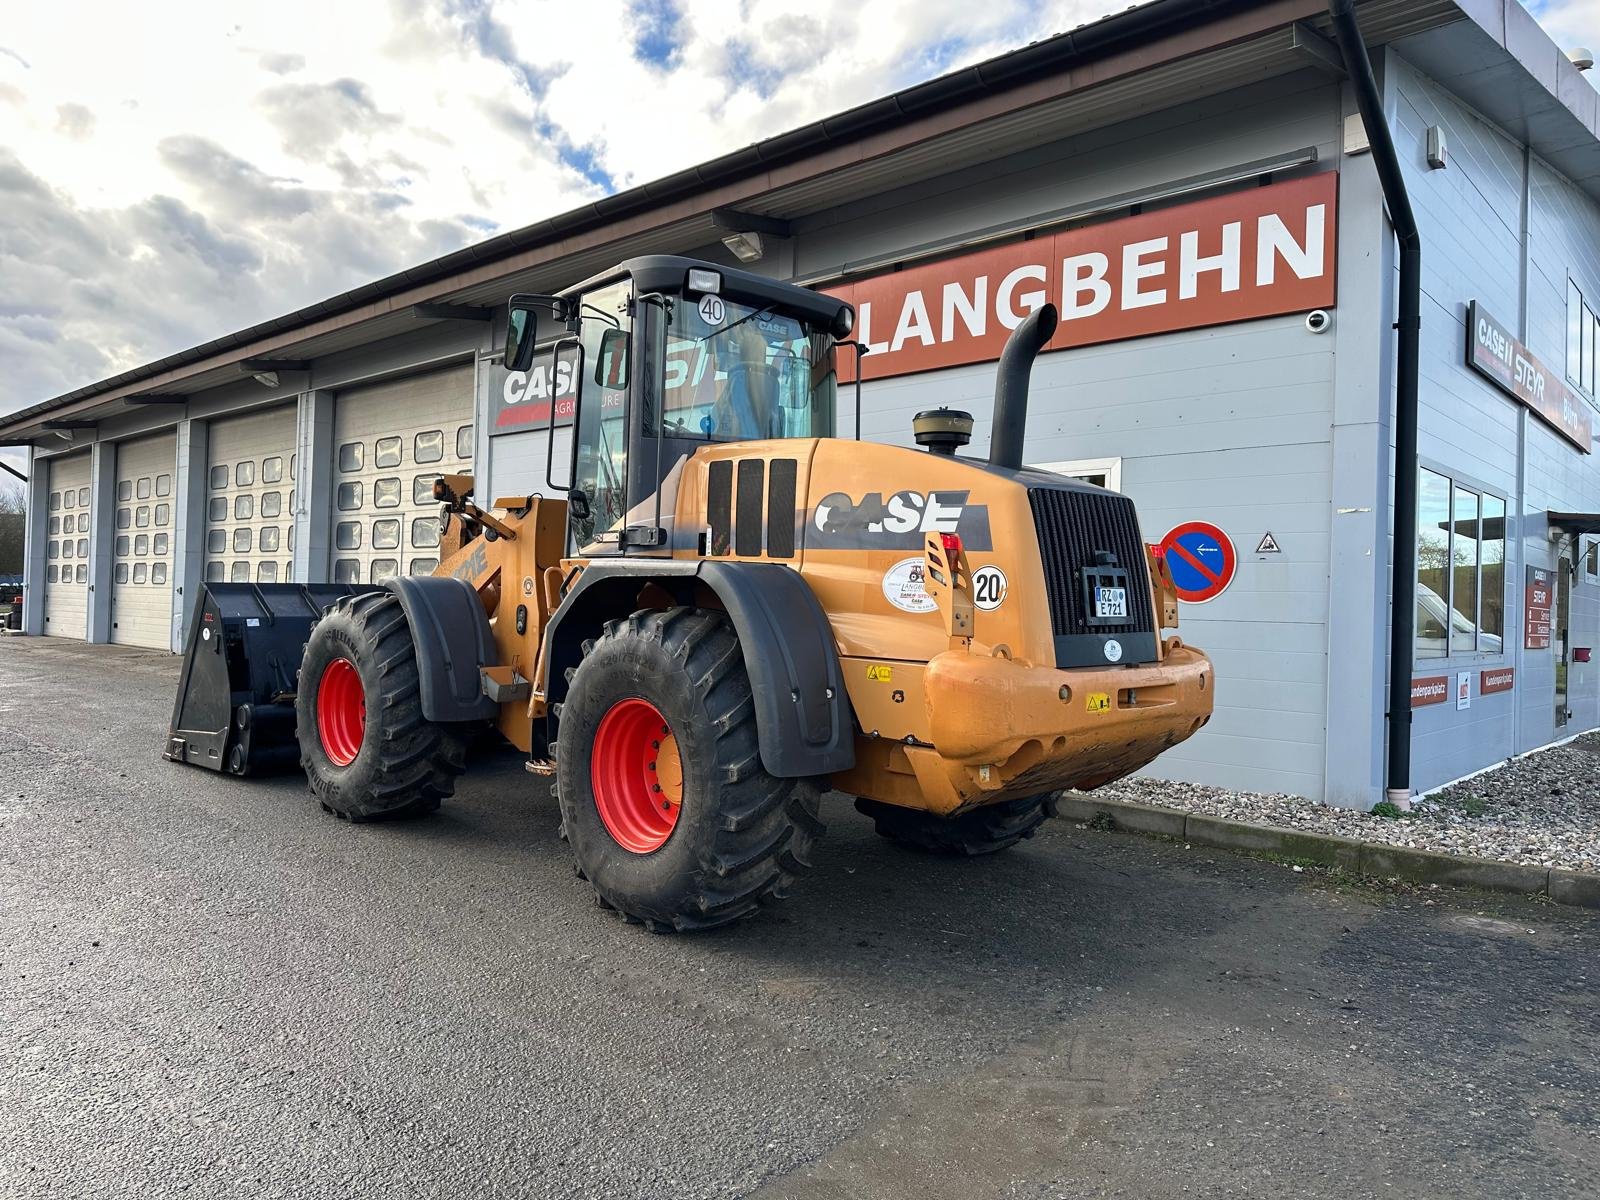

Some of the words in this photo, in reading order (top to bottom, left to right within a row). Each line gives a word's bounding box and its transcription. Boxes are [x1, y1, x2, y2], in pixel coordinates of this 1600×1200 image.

[858, 203, 1326, 357] LANGBEHN
[701, 298, 722, 321] 40
[758, 321, 788, 335] CASE
[1479, 318, 1505, 361] CASE
[1514, 353, 1545, 401] STEYR
[503, 360, 577, 404] CAS
[976, 573, 1000, 603] 20
[1101, 589, 1112, 603] RZ
[1101, 603, 1107, 615] E
[1108, 603, 1122, 616] 721
[1411, 683, 1446, 699] undenparkplatz
